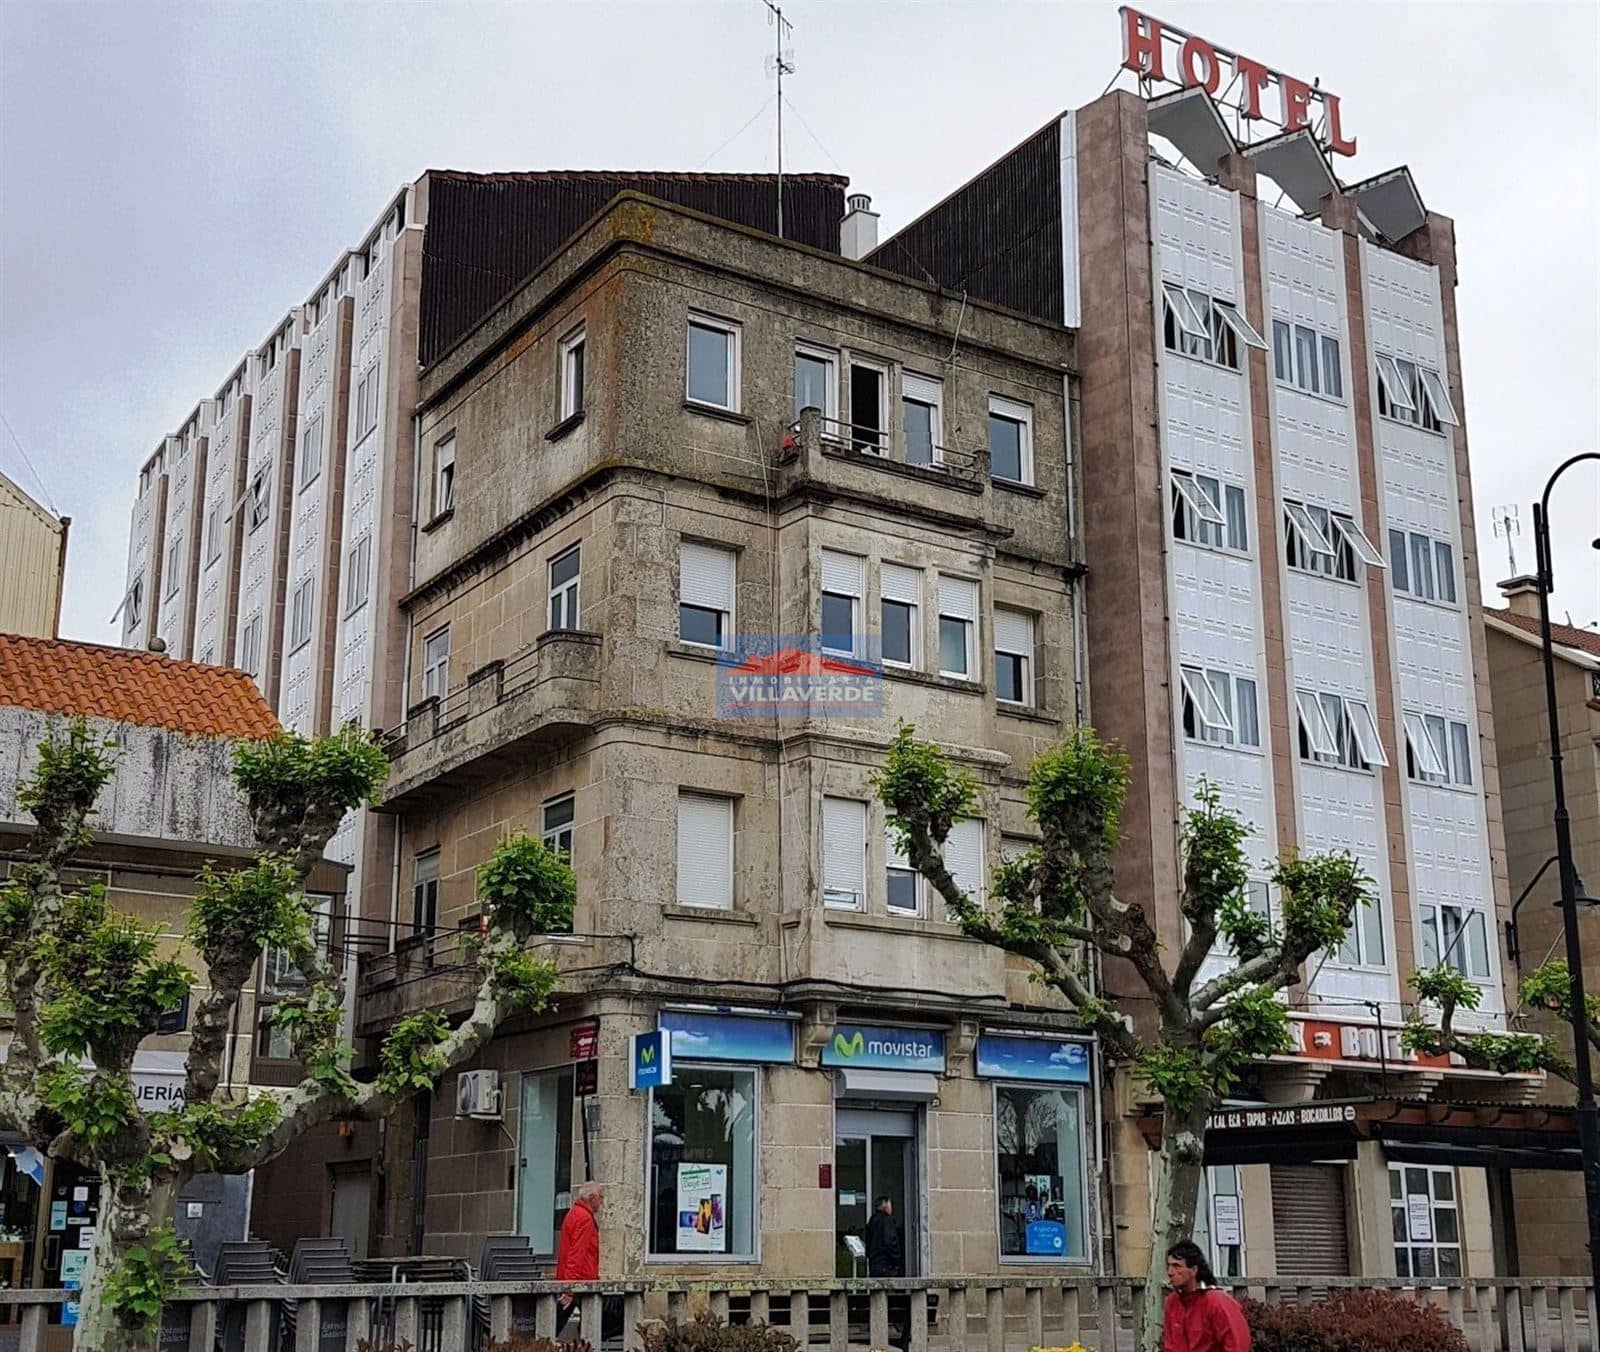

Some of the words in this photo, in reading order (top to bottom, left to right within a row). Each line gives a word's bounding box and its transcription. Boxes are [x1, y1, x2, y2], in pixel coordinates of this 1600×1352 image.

[1119, 6, 1356, 157] HOTEL
[868, 1040, 933, 1058] movistar
[1301, 1107, 1344, 1124] BOCADILLOS
